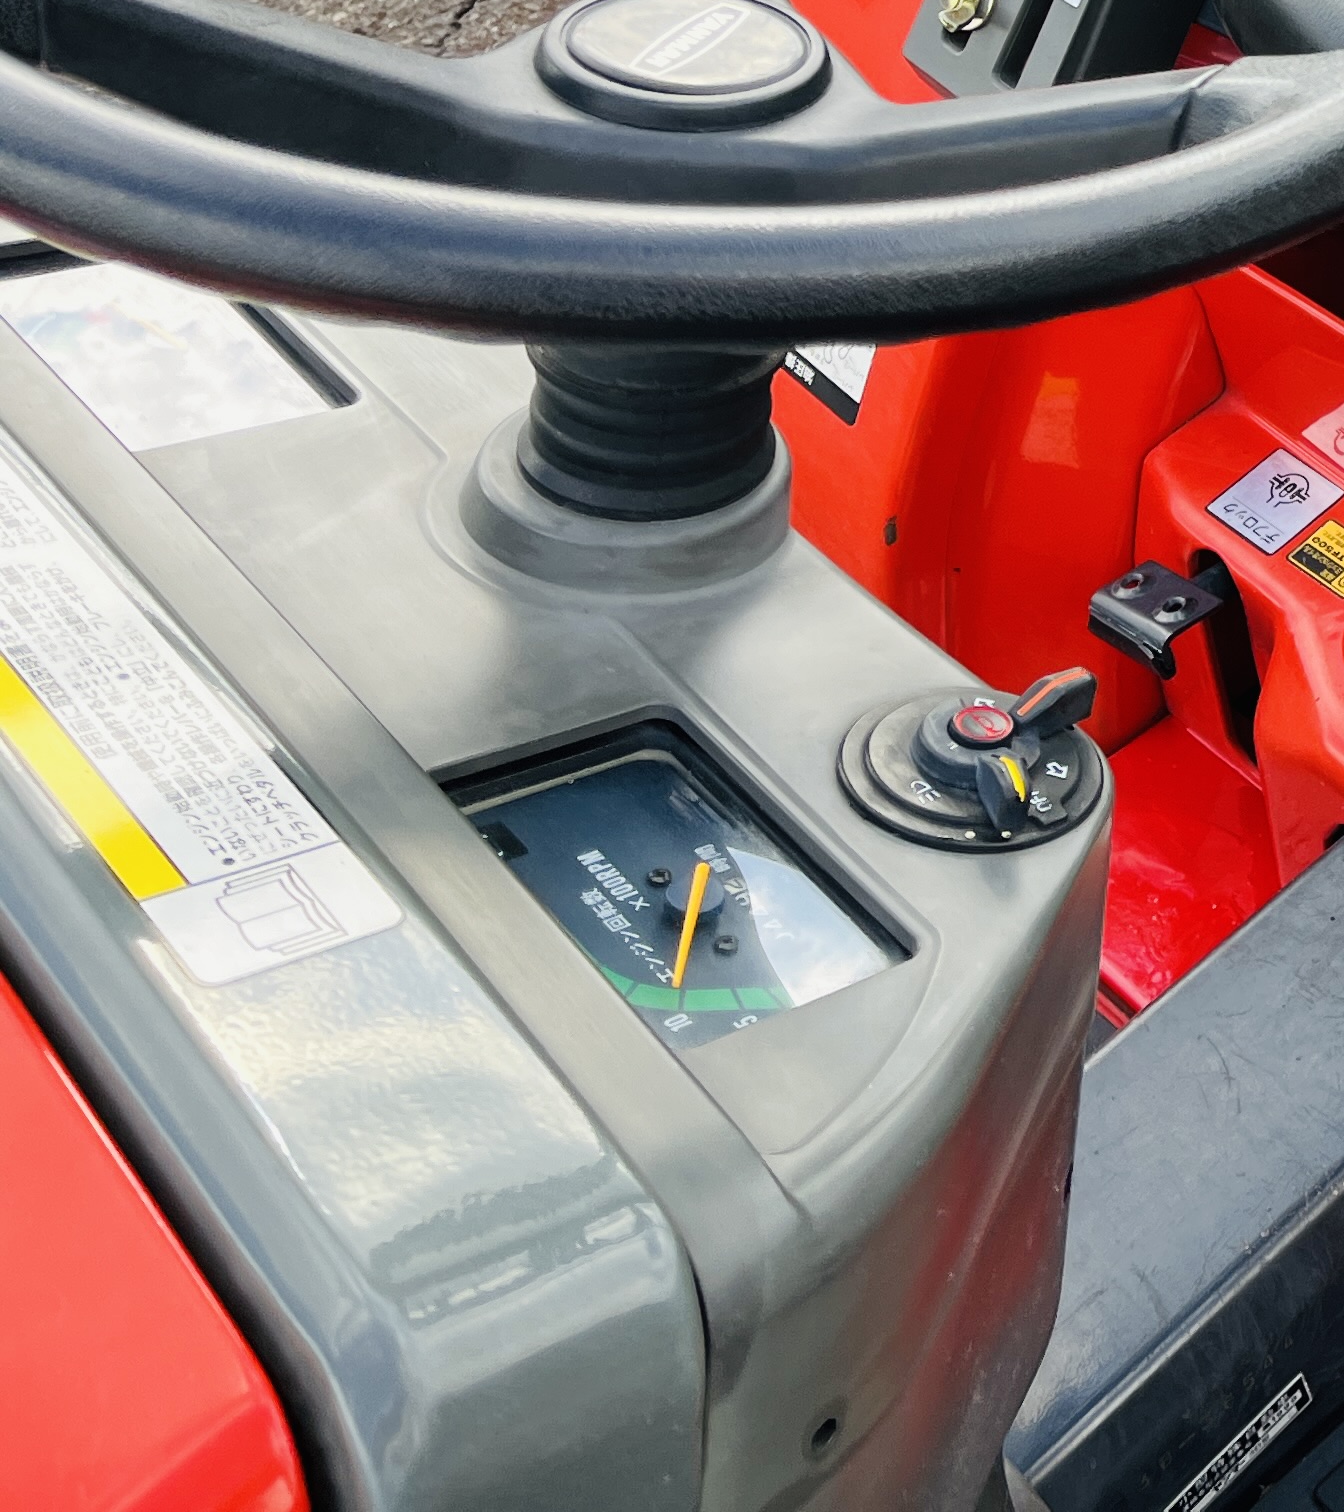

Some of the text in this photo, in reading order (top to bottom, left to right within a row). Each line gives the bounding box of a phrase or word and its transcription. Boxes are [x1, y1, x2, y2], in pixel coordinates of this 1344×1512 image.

[1220, 499, 1281, 546] デフロック
[662, 1010, 692, 1034] 10
